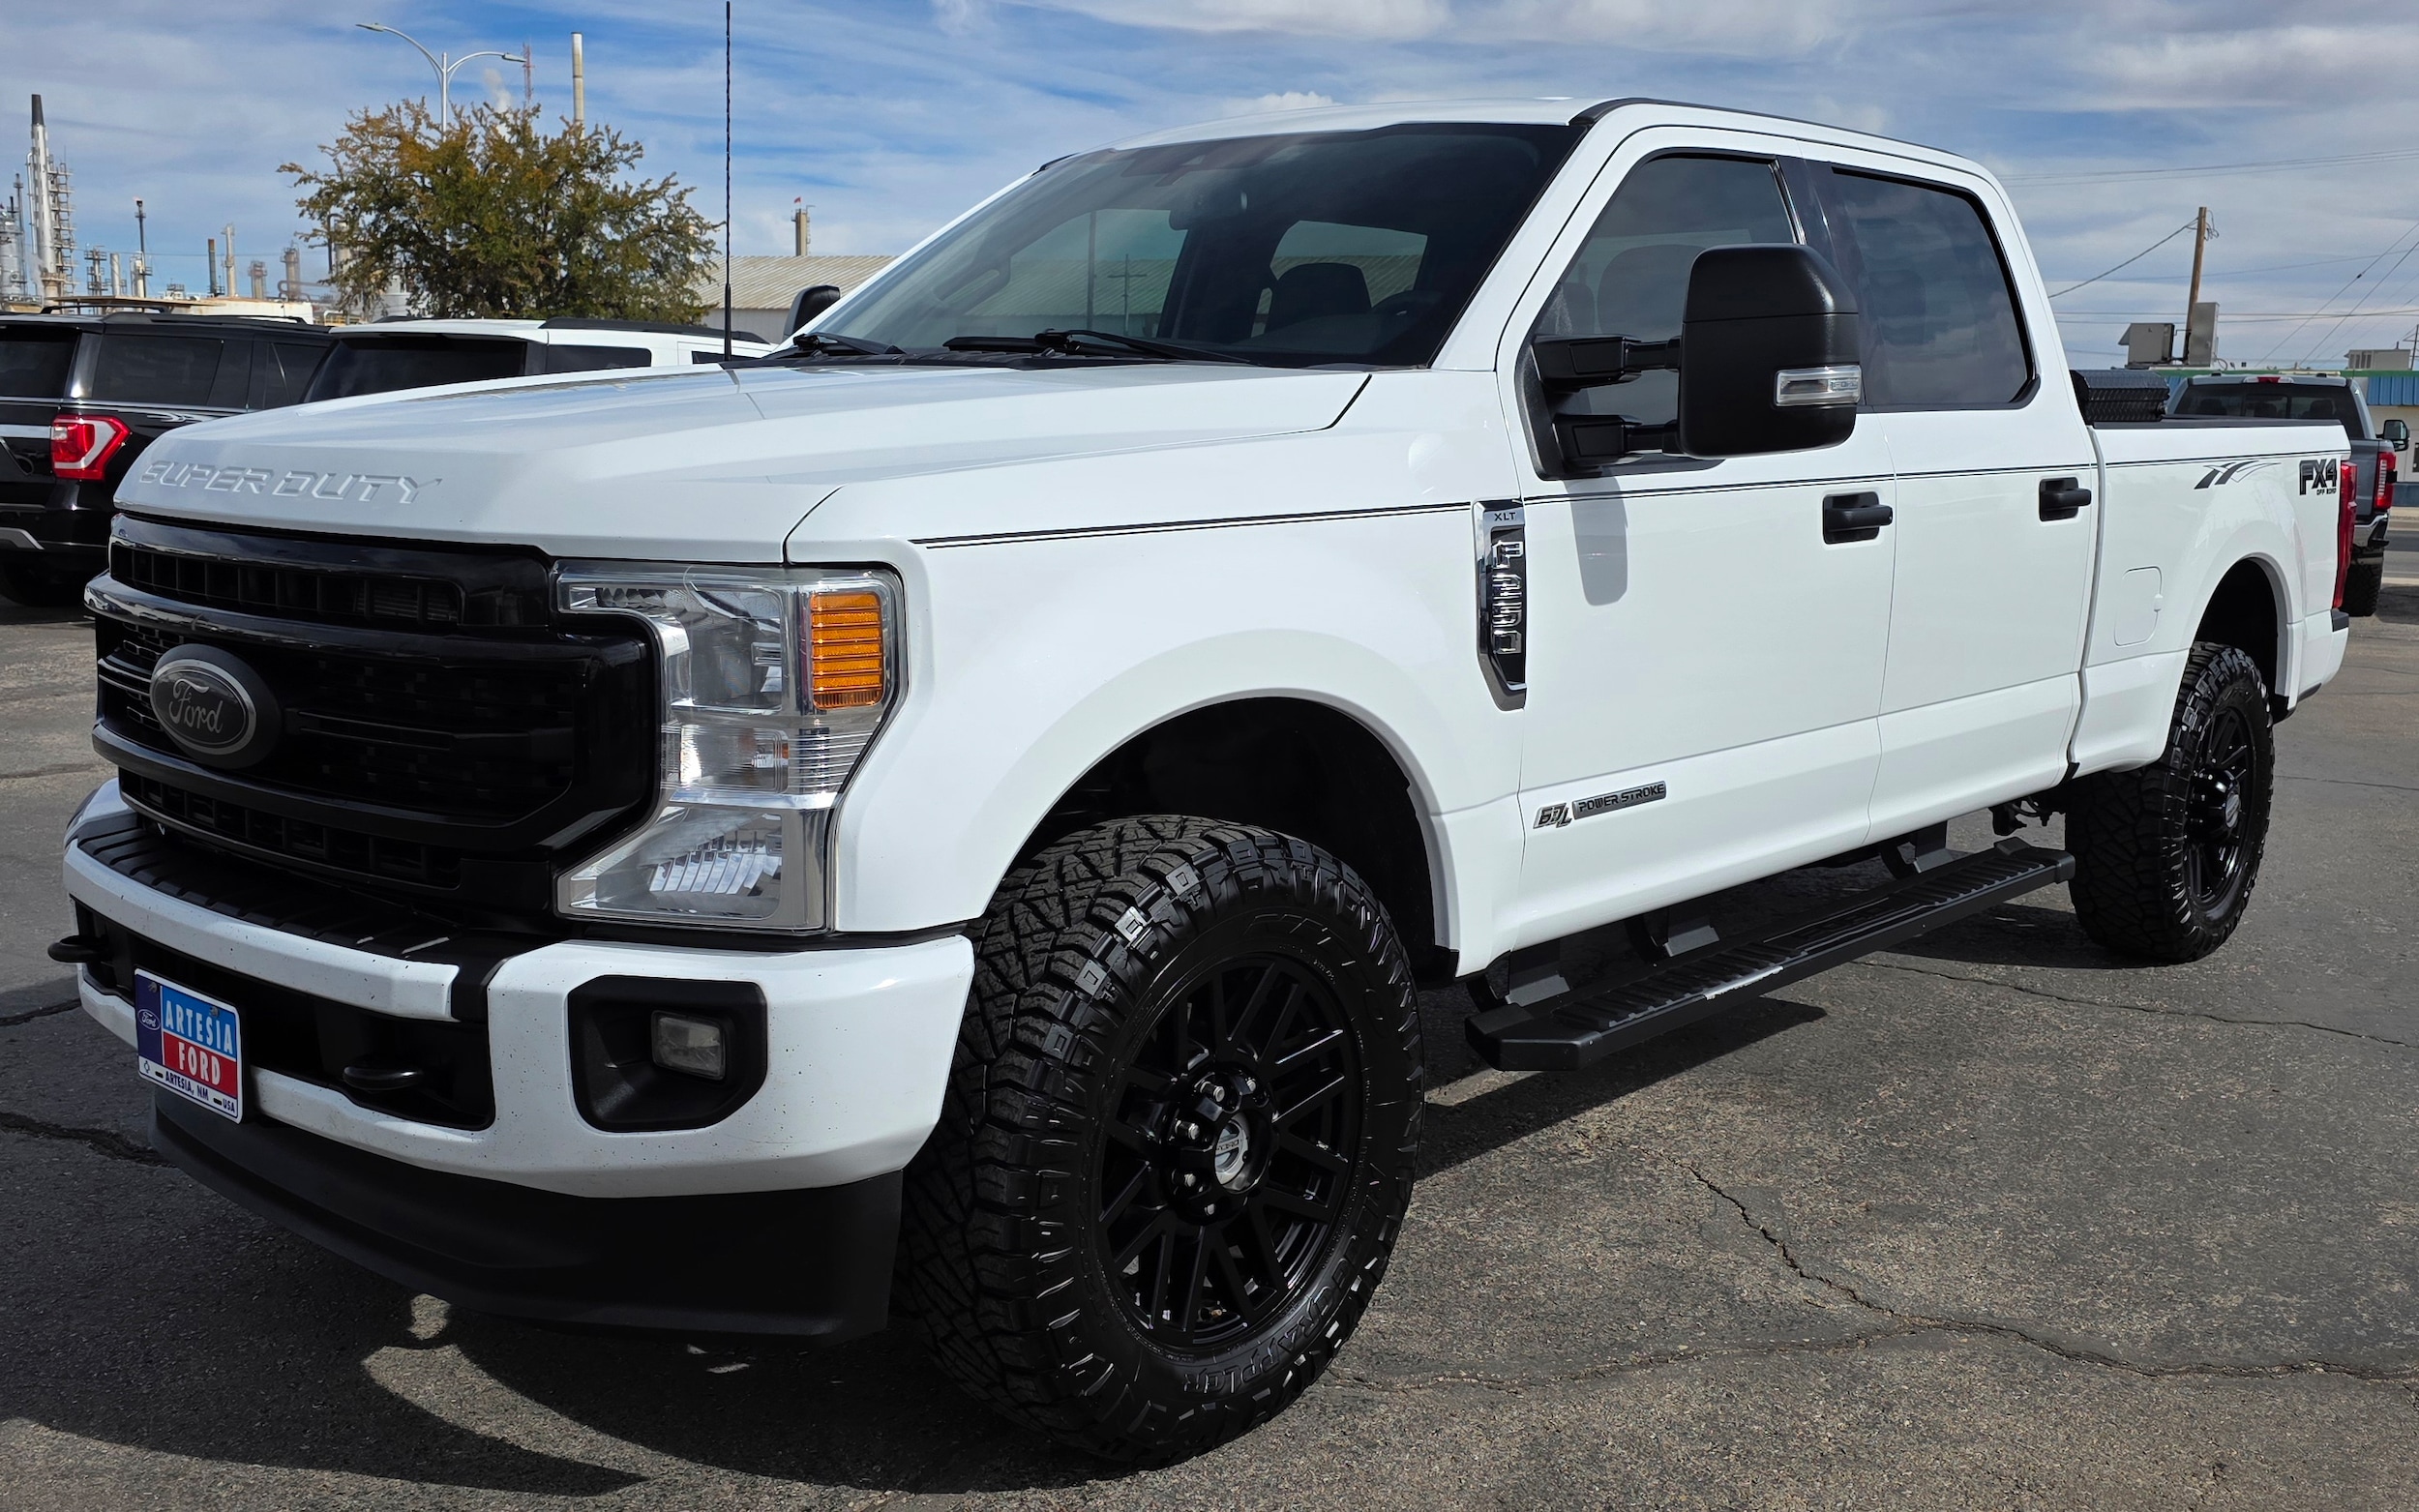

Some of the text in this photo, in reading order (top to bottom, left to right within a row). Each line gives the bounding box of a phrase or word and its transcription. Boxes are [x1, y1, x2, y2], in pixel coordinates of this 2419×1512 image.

[139, 460, 443, 504] SUPER DUTY
[2299, 459, 2338, 495] FX4
[1494, 512, 1516, 521] XLT
[168, 678, 224, 733] Ford
[1578, 794, 1619, 813] POWER
[1621, 784, 1665, 803] STROKE
[141, 1011, 157, 1028] Ford
[165, 1000, 233, 1054] ARTESIA
[178, 1041, 221, 1085] FORD
[165, 1071, 235, 1113] ARTESIA, NM USA
